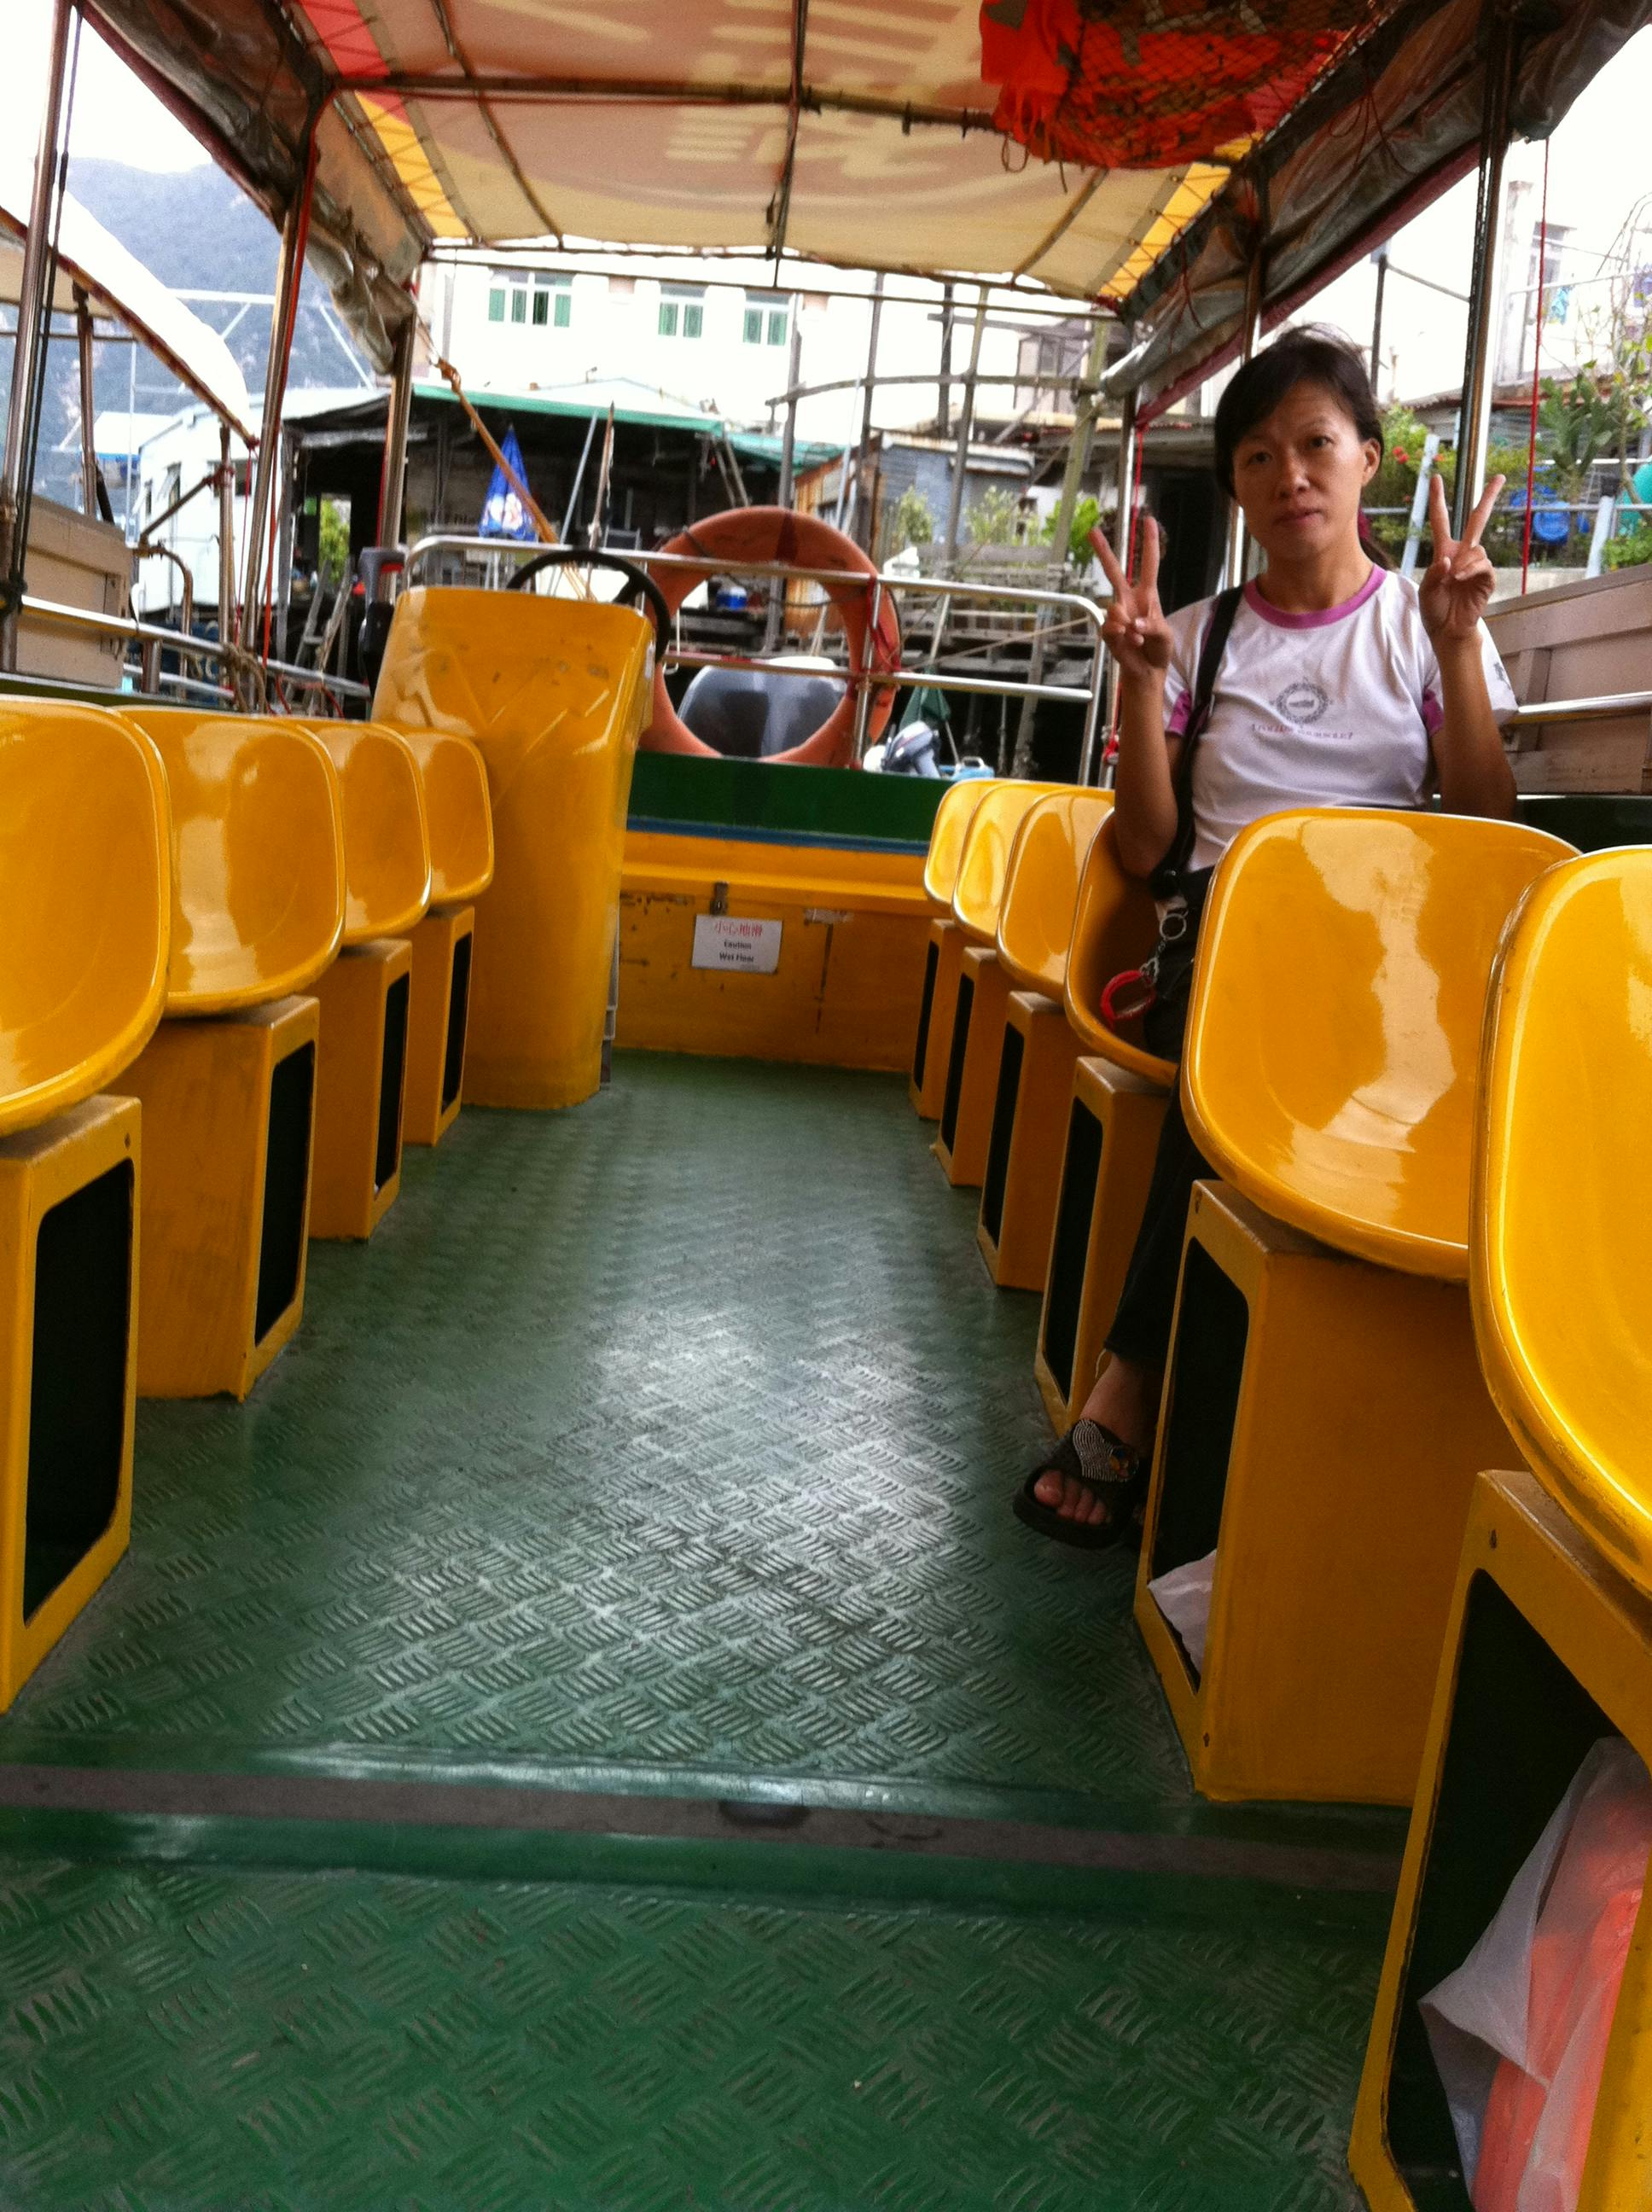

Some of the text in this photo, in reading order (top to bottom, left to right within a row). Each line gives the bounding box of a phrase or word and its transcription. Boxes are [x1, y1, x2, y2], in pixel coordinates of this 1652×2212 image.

[724, 940, 752, 950] Caution
[719, 952, 754, 963] Wet Floor
